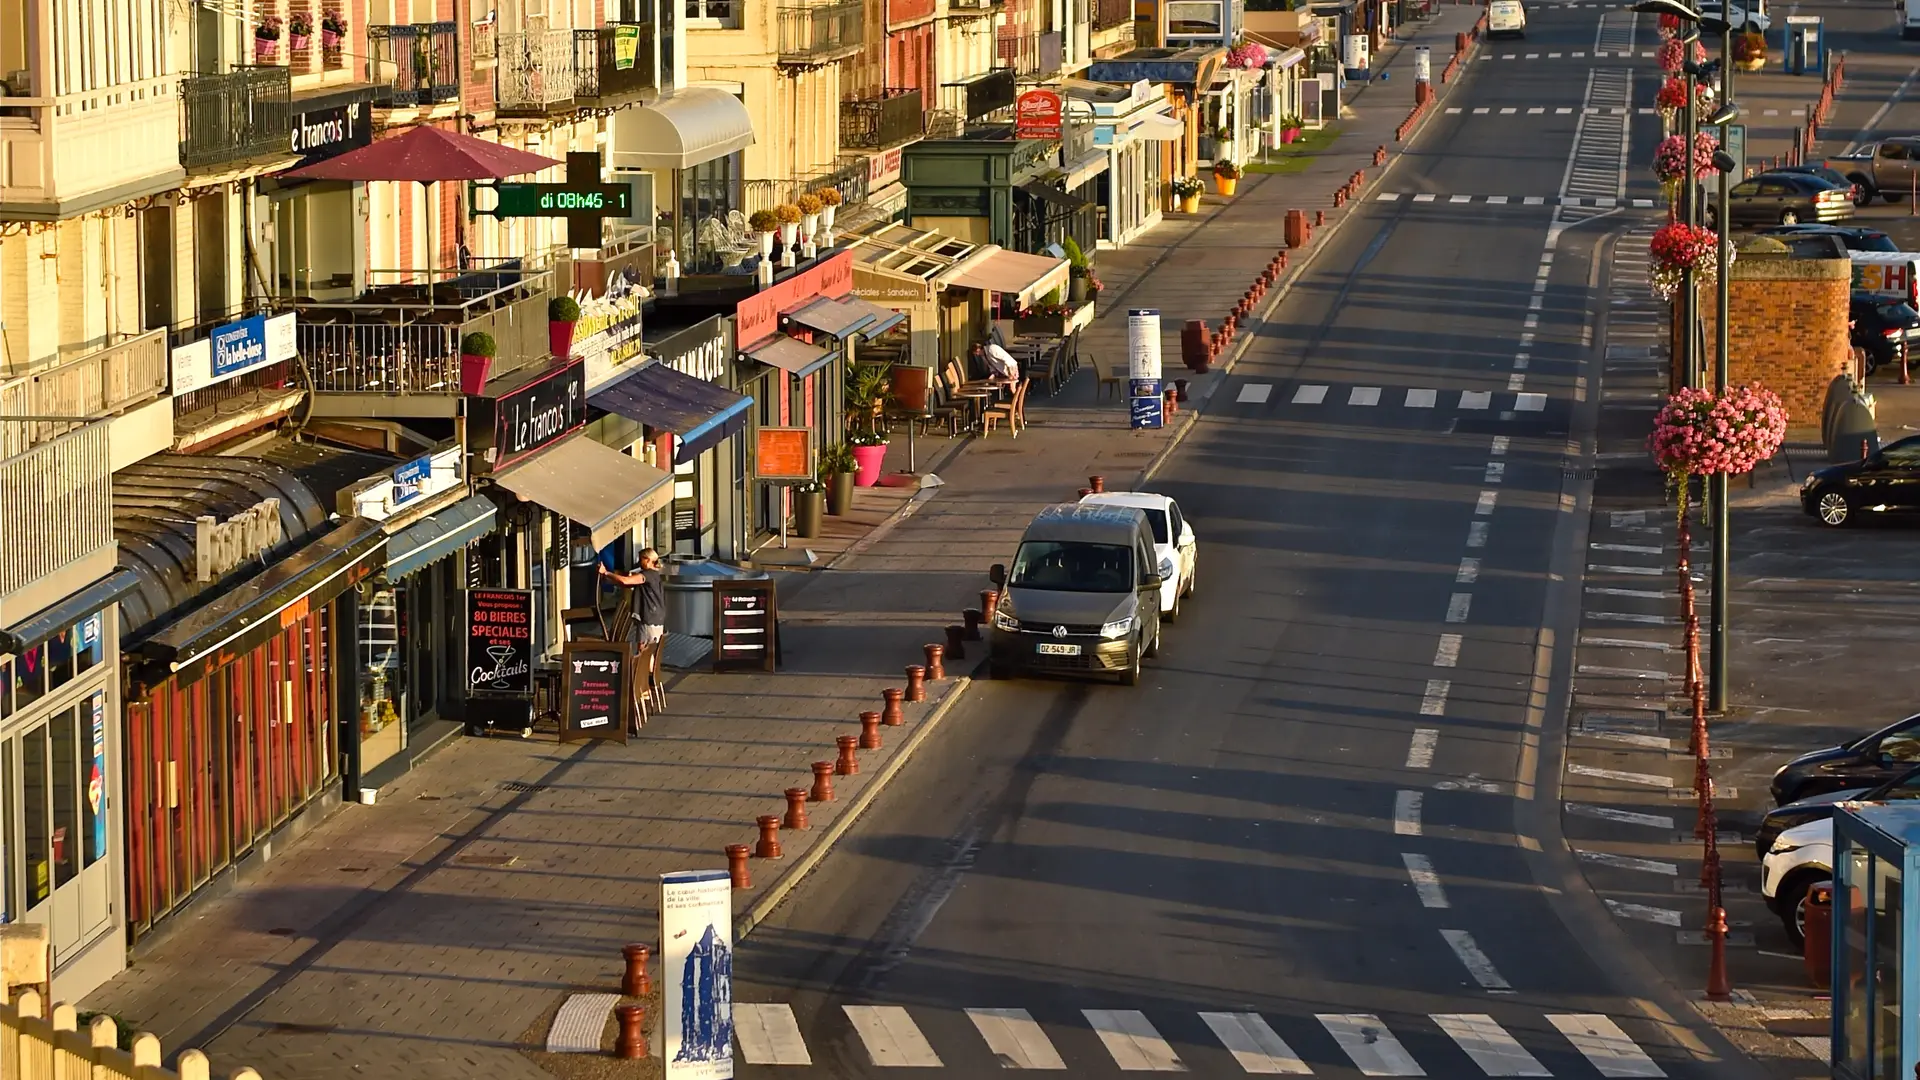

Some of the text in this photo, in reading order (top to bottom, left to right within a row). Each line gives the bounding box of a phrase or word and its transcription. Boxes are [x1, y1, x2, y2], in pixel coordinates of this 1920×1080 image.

[540, 192, 553, 208] di
[557, 192, 603, 208] 08h45
[887, 286, 919, 298] Sandwich
[514, 403, 528, 452] Le
[567, 380, 578, 424] 1er
[474, 610, 526, 623] 80 BIERES
[471, 625, 528, 638] SPECIALES
[471, 659, 528, 684] Cocktails
